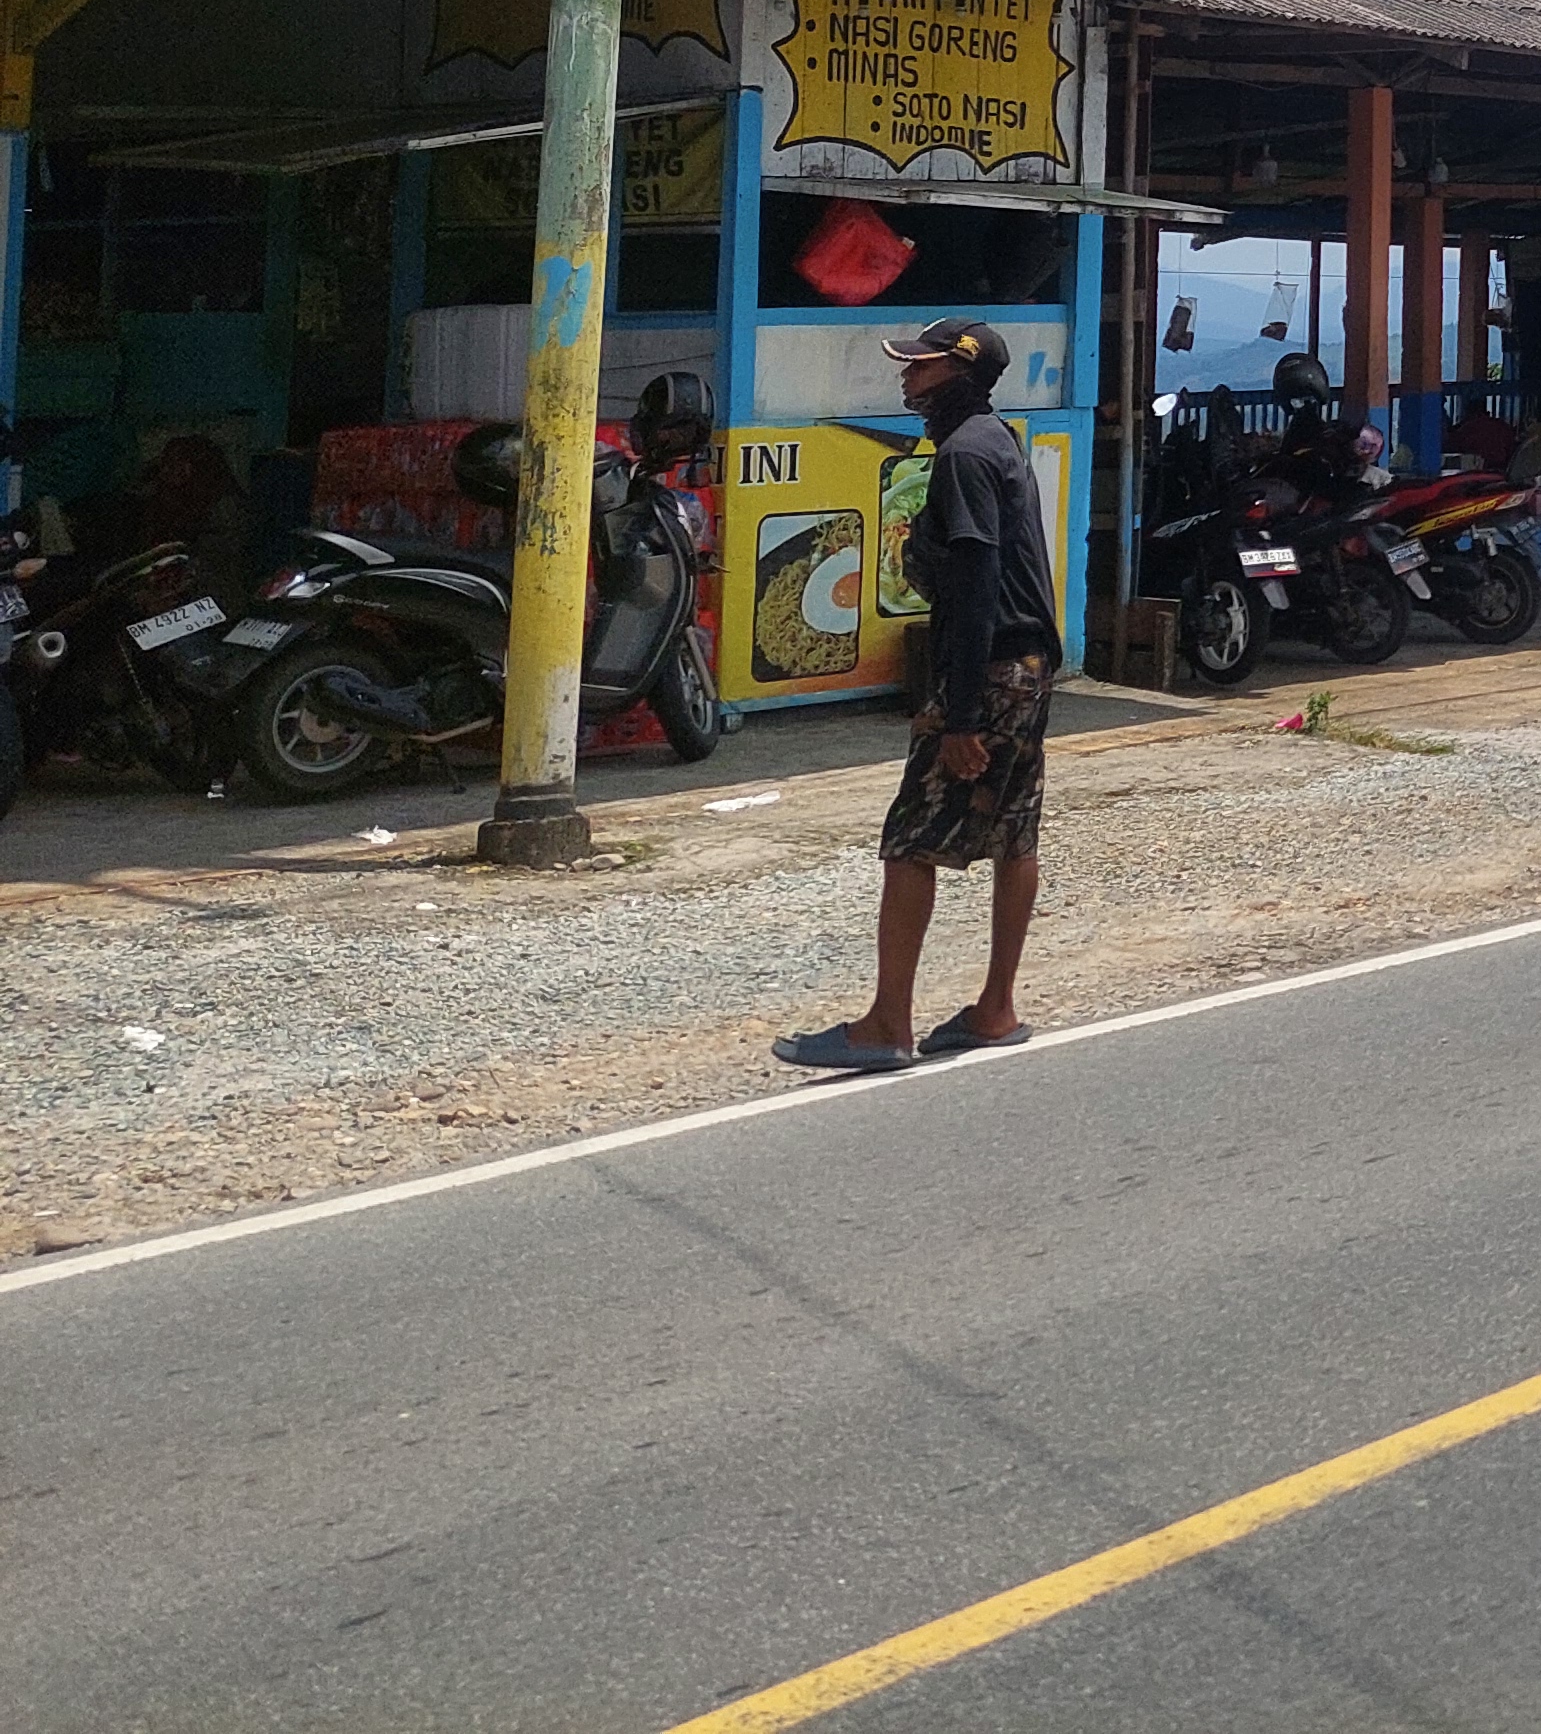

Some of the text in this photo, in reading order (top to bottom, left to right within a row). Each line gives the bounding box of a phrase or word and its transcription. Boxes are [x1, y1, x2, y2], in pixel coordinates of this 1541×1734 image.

[828, 12, 1018, 64] NASI GORENG
[826, 47, 919, 88] MINAS
[891, 91, 1028, 131] SOTO NASI
[890, 120, 994, 158] INDOMIE
[738, 443, 801, 485] INI
[128, 597, 216, 638] BM 4922 NZ
